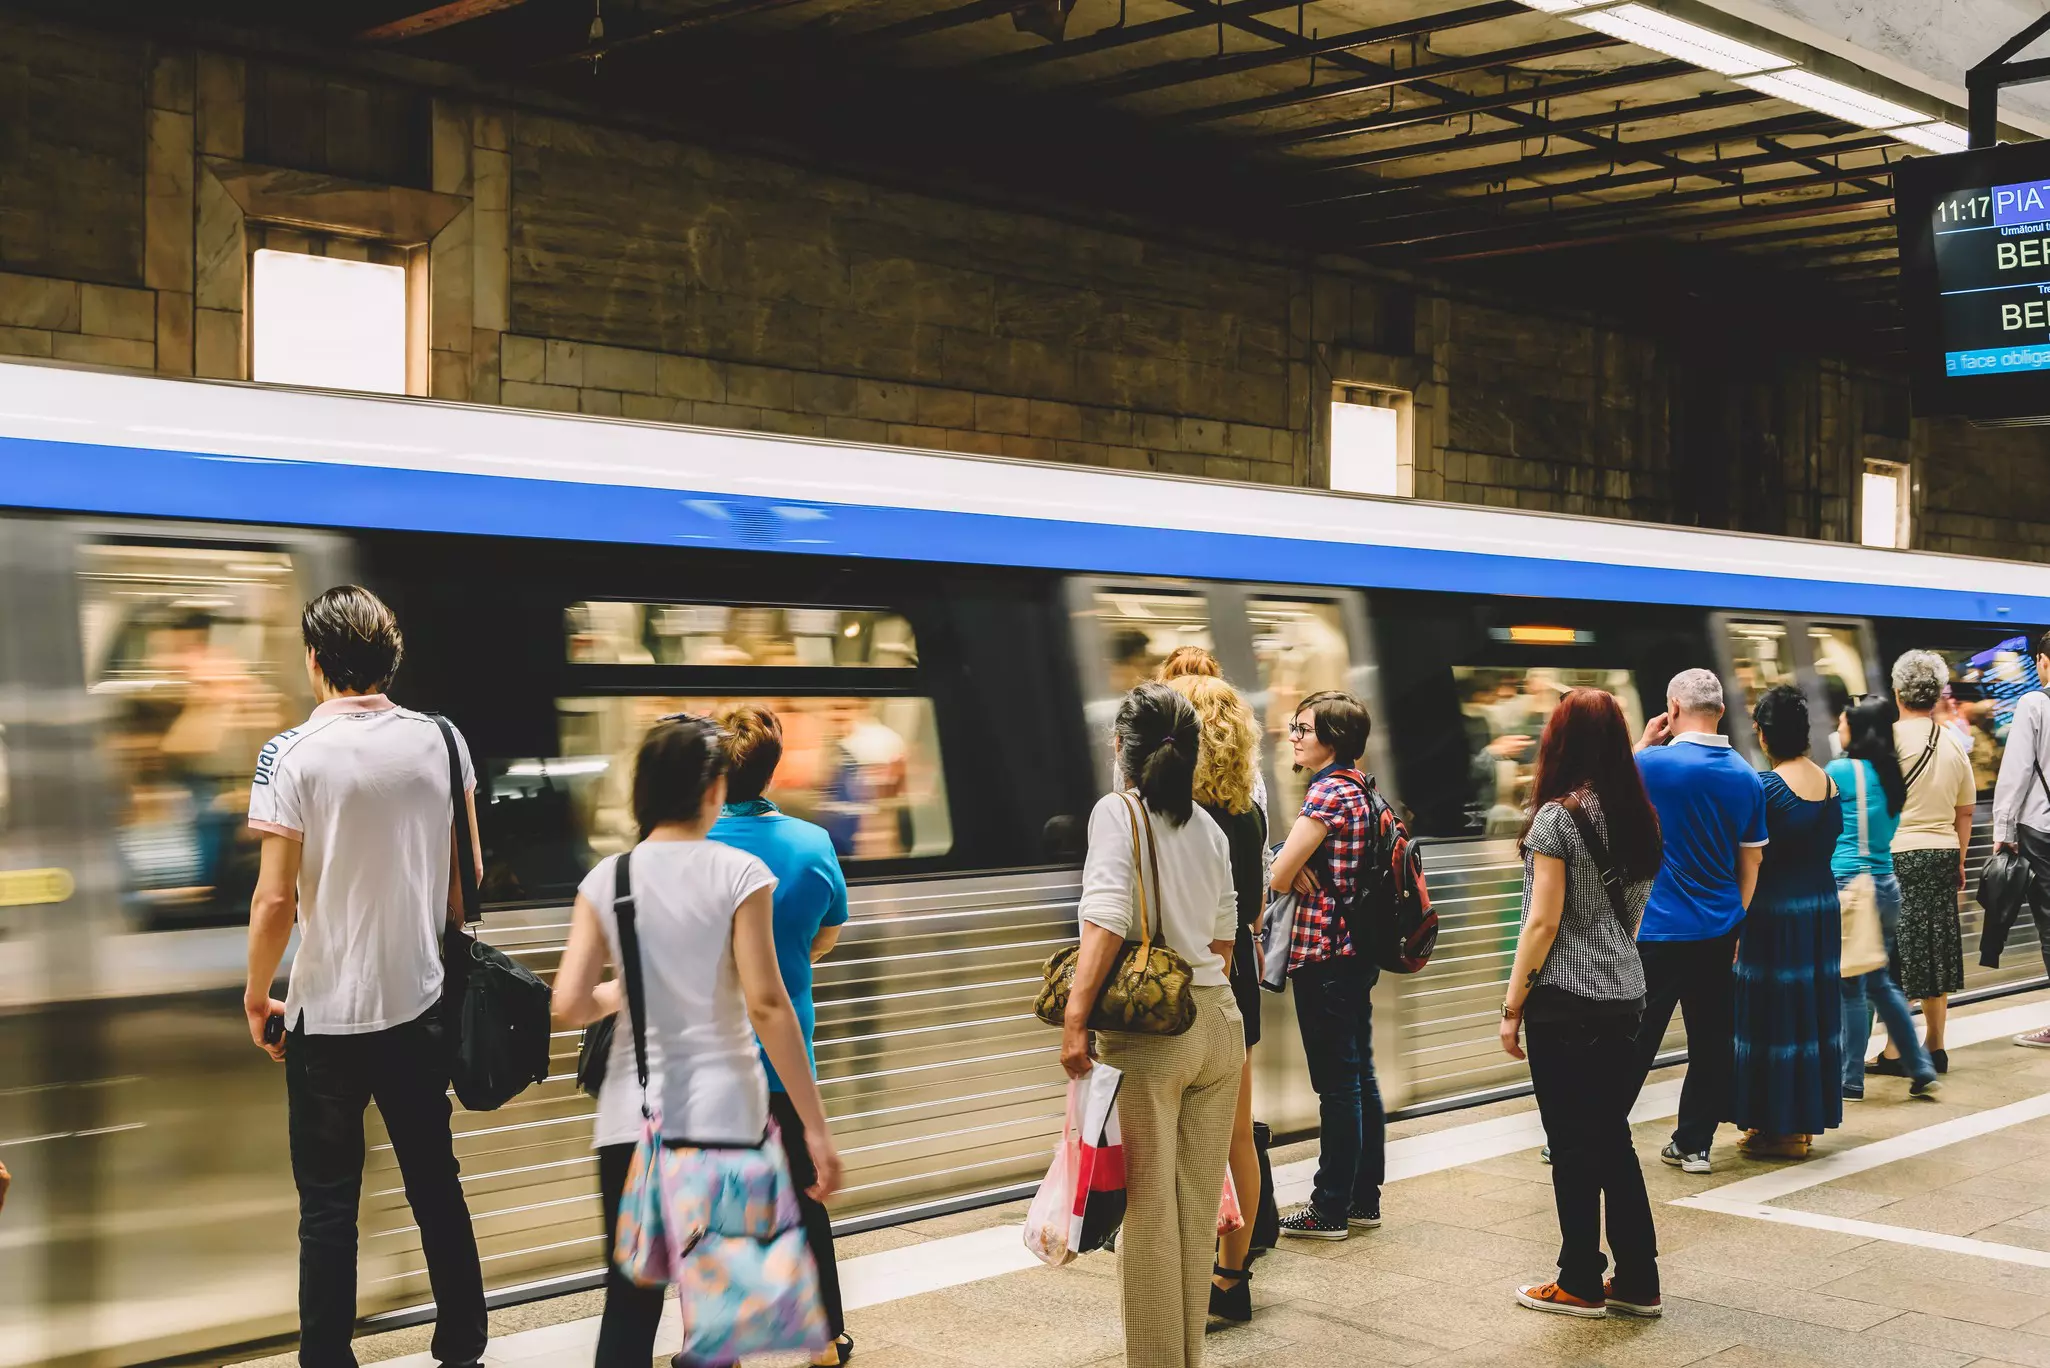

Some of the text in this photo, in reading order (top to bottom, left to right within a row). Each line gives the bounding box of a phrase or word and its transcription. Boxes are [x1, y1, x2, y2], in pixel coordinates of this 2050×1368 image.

[1937, 196, 1990, 222] 11:17
[2001, 300, 2050, 331] BE
[1960, 354, 1997, 369] face
